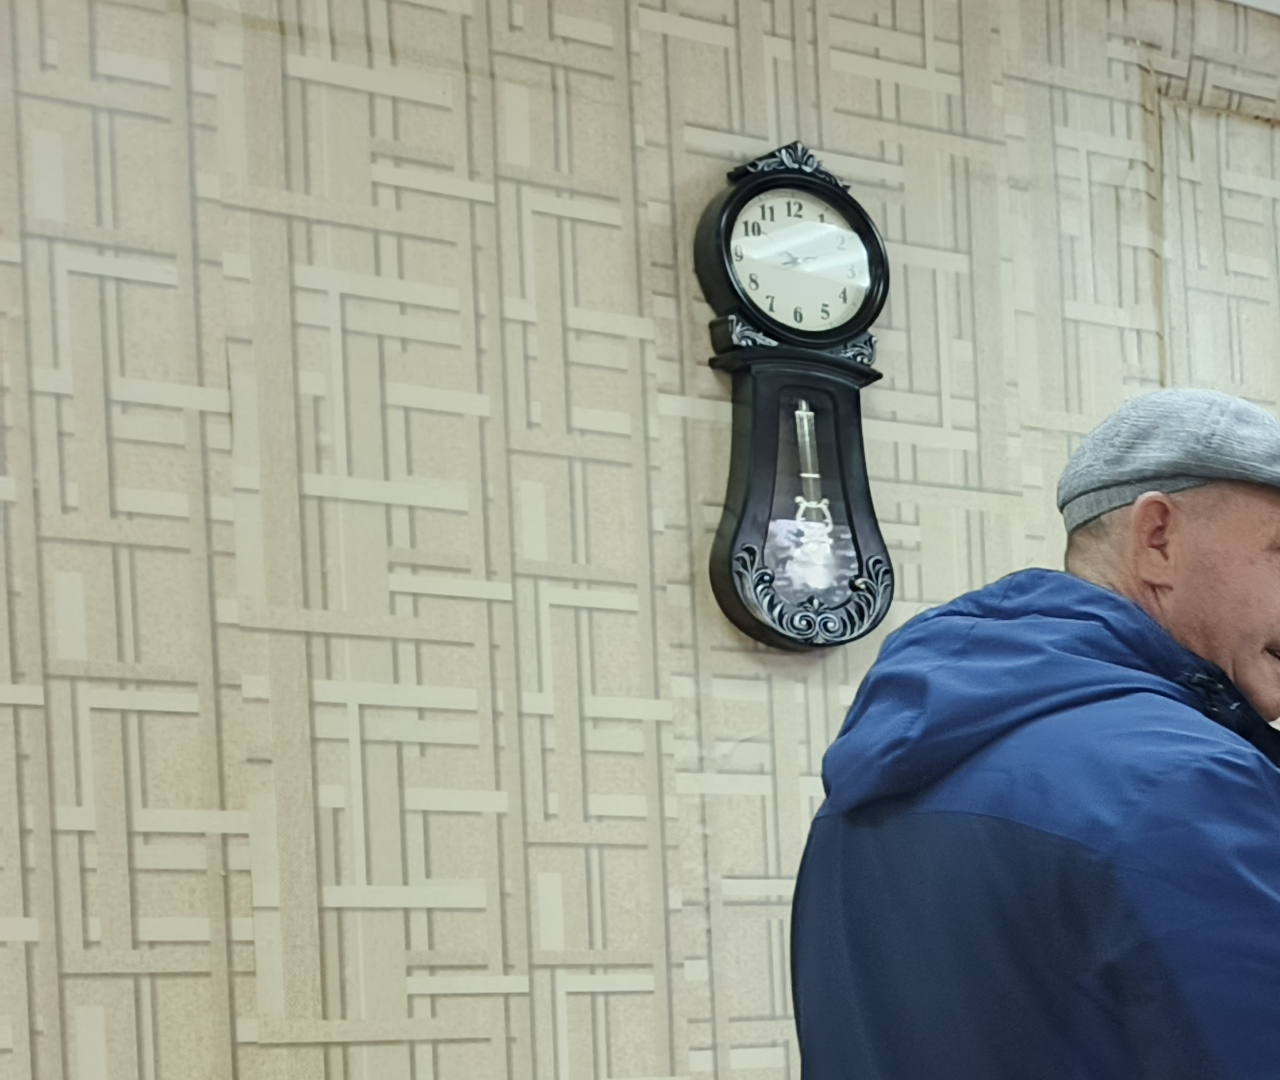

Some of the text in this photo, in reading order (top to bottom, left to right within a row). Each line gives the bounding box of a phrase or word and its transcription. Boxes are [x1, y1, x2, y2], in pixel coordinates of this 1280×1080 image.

[760, 204, 775, 222] 11
[786, 200, 803, 219] 12
[743, 220, 761, 237] 10
[836, 235, 845, 251] 2
[734, 245, 744, 262] 9
[846, 264, 856, 279] 3
[748, 273, 759, 291] 8
[765, 294, 775, 313] 7
[838, 287, 848, 304] 4
[793, 306, 804, 324] 6
[820, 303, 831, 320] 5
